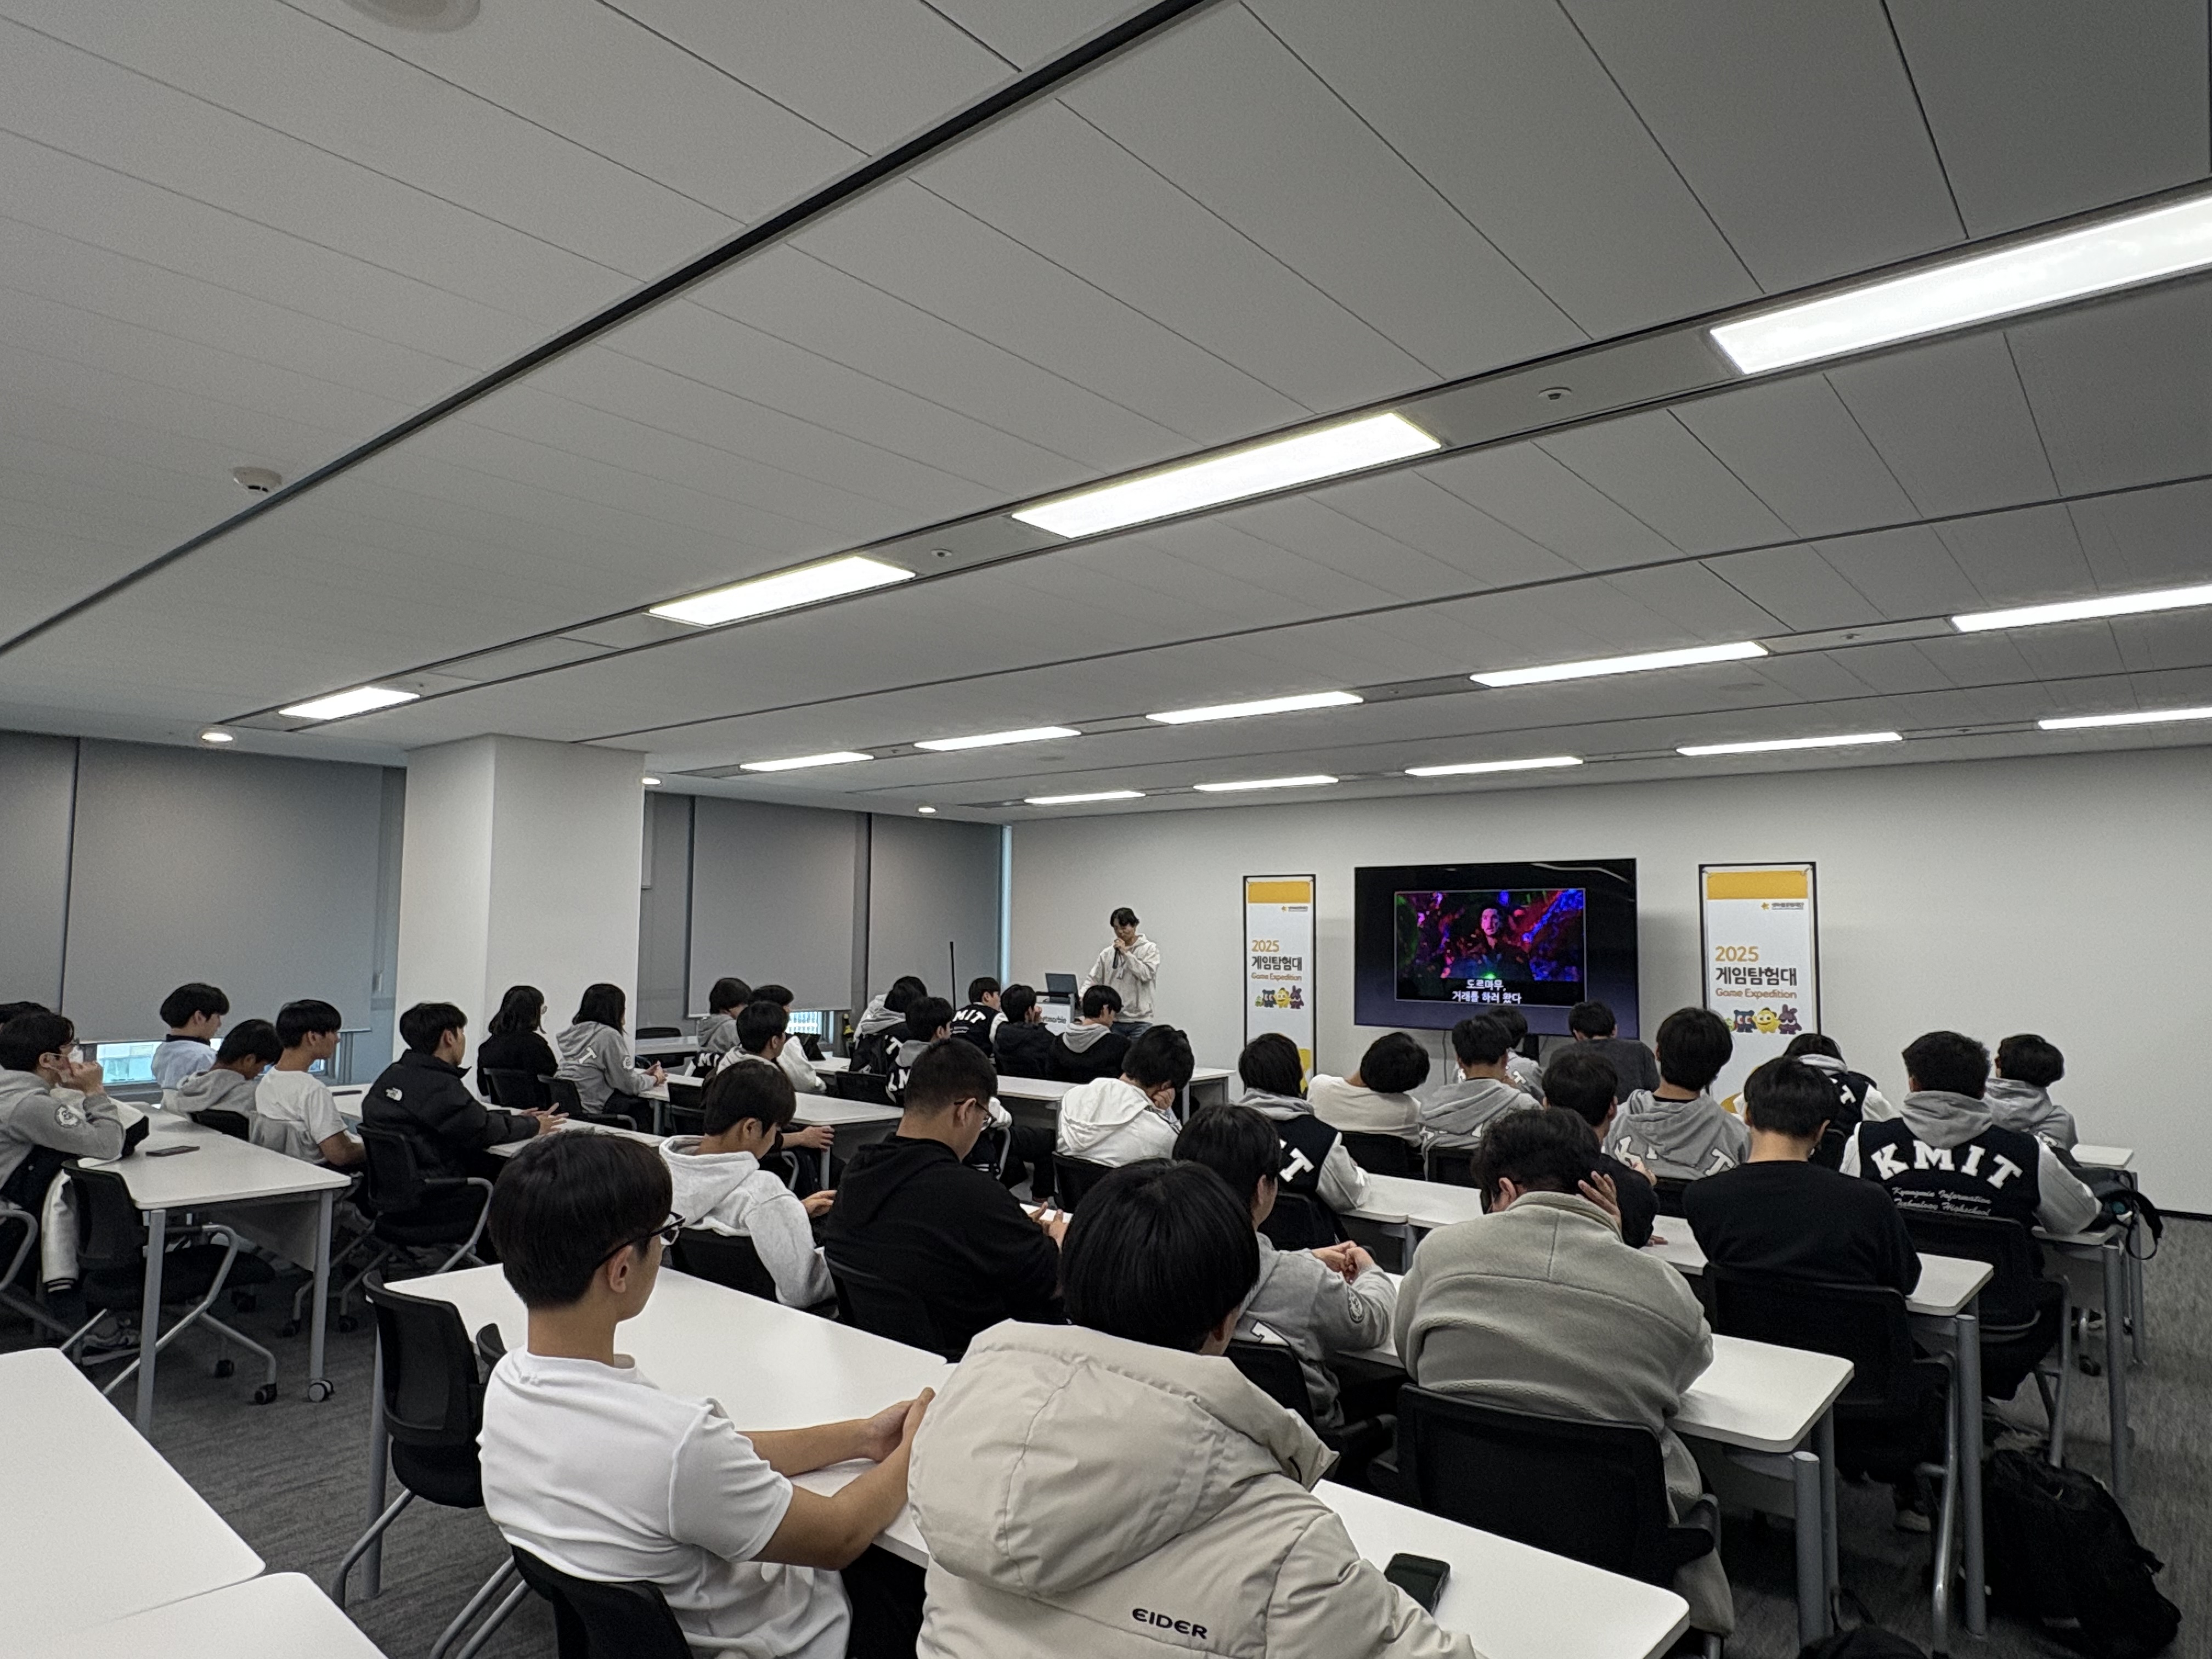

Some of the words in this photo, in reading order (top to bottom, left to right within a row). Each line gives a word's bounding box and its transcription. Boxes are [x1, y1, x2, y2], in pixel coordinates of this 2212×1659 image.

[1251, 939, 1279, 952] 2025
[1715, 945, 1759, 962] 2025
[1251, 956, 1302, 971] 게임탐험대
[1251, 972, 1268, 980] Game
[1269, 972, 1302, 981] Expedition
[1716, 967, 1797, 986] 게임탐험대
[1452, 990, 1480, 1003] 거래를
[1482, 991, 1500, 1004] 하러
[1716, 988, 1743, 997] Game
[1745, 988, 1797, 1000] Expedition
[952, 1009, 986, 1024] MIT
[1871, 1140, 2023, 1189] KMIT
[1132, 1607, 1208, 1640] EIDER
